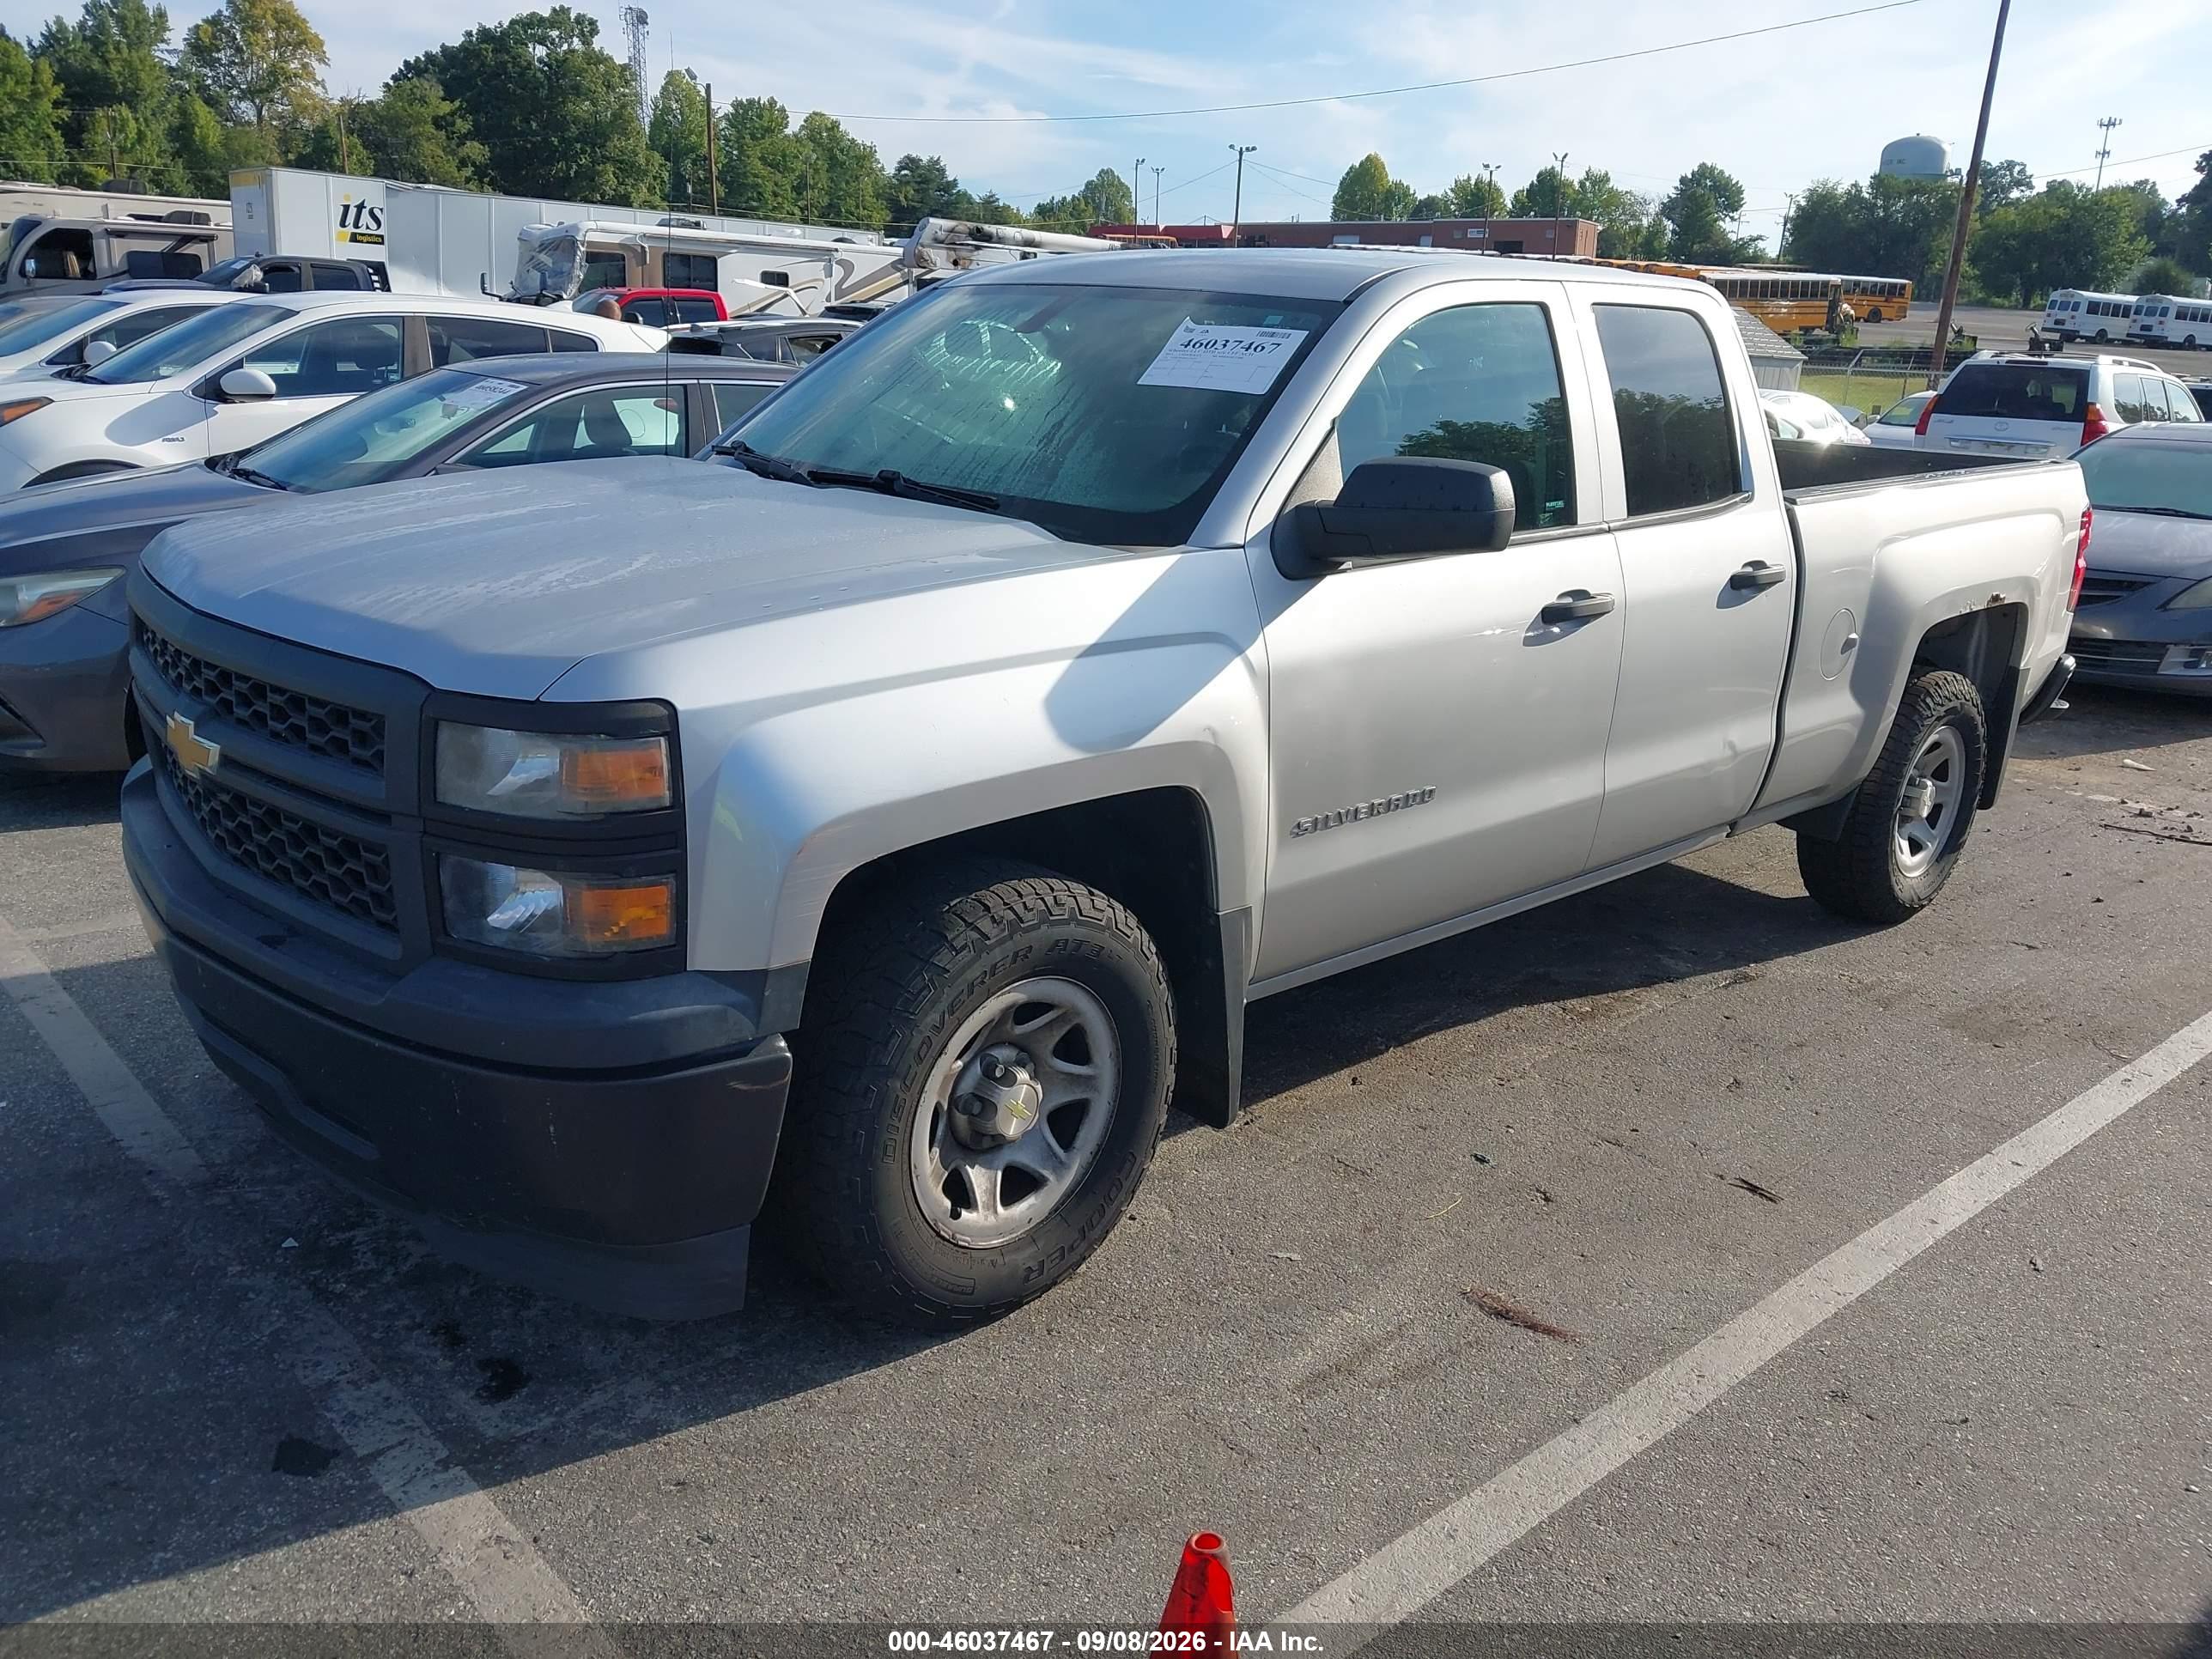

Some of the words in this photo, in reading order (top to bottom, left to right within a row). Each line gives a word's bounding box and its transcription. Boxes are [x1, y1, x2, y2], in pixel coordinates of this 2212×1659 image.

[338, 192, 384, 231] its
[356, 234, 382, 243] logistics
[1179, 337, 1283, 355] 46037467
[1290, 785, 1437, 839] SILVERADO
[881, 945, 1034, 1164] DISCOVERER
[1022, 1150, 1139, 1285] COOPER
